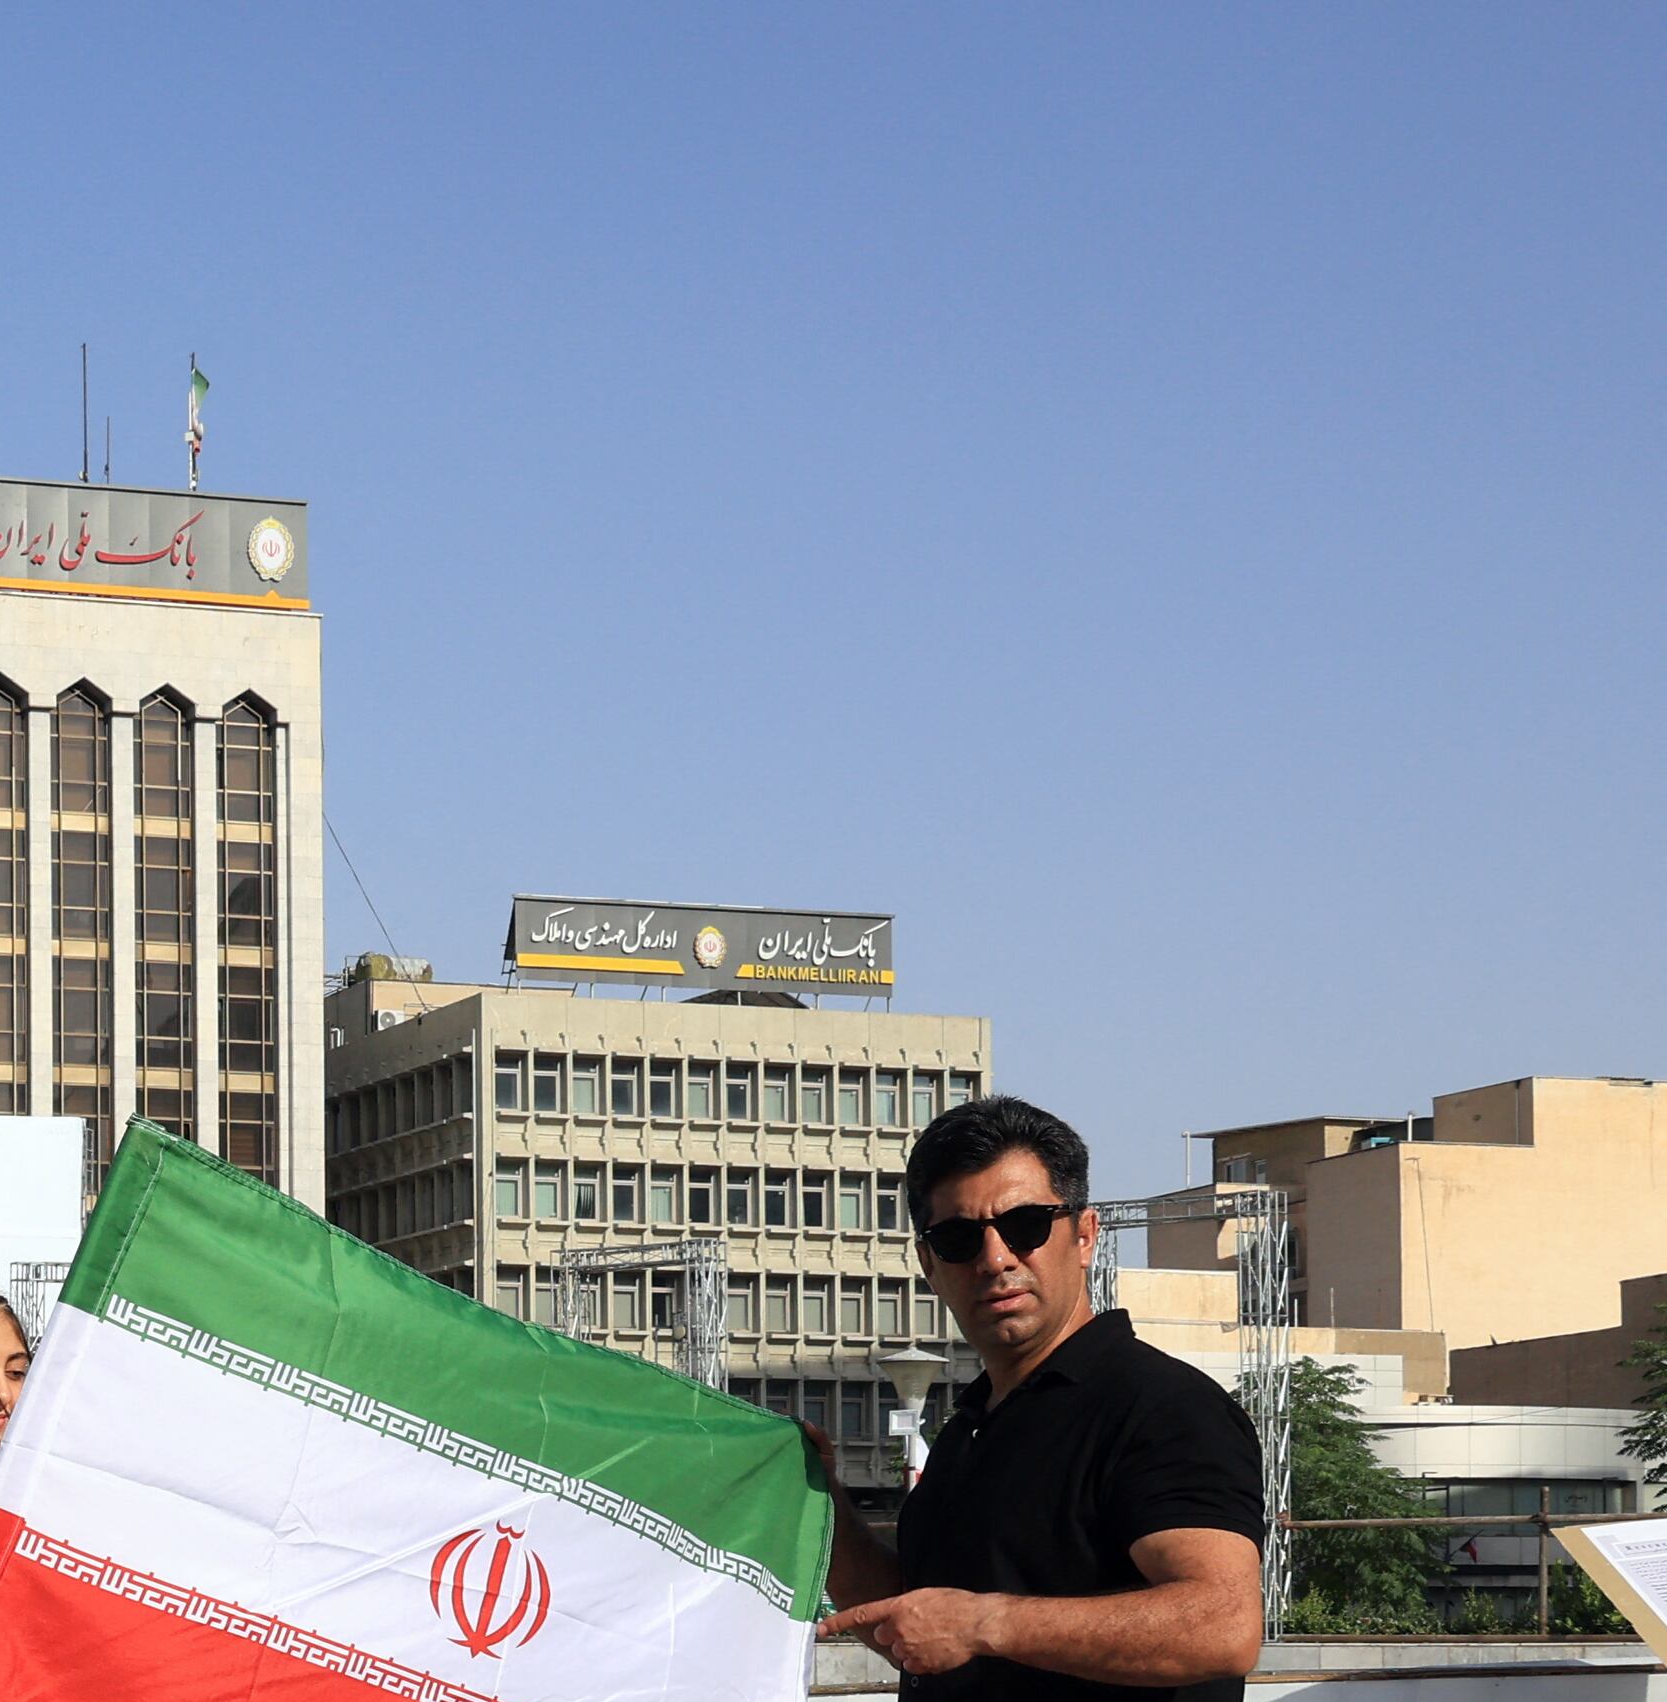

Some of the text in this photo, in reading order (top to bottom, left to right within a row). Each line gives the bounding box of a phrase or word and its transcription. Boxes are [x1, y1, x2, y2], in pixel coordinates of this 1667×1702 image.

[94, 509, 205, 580] بانک
[574, 921, 626, 951] مهندسی
[622, 910, 655, 954] کل
[642, 929, 678, 950] اداره
[758, 930, 813, 960] ایران
[829, 919, 889, 967] بانک
